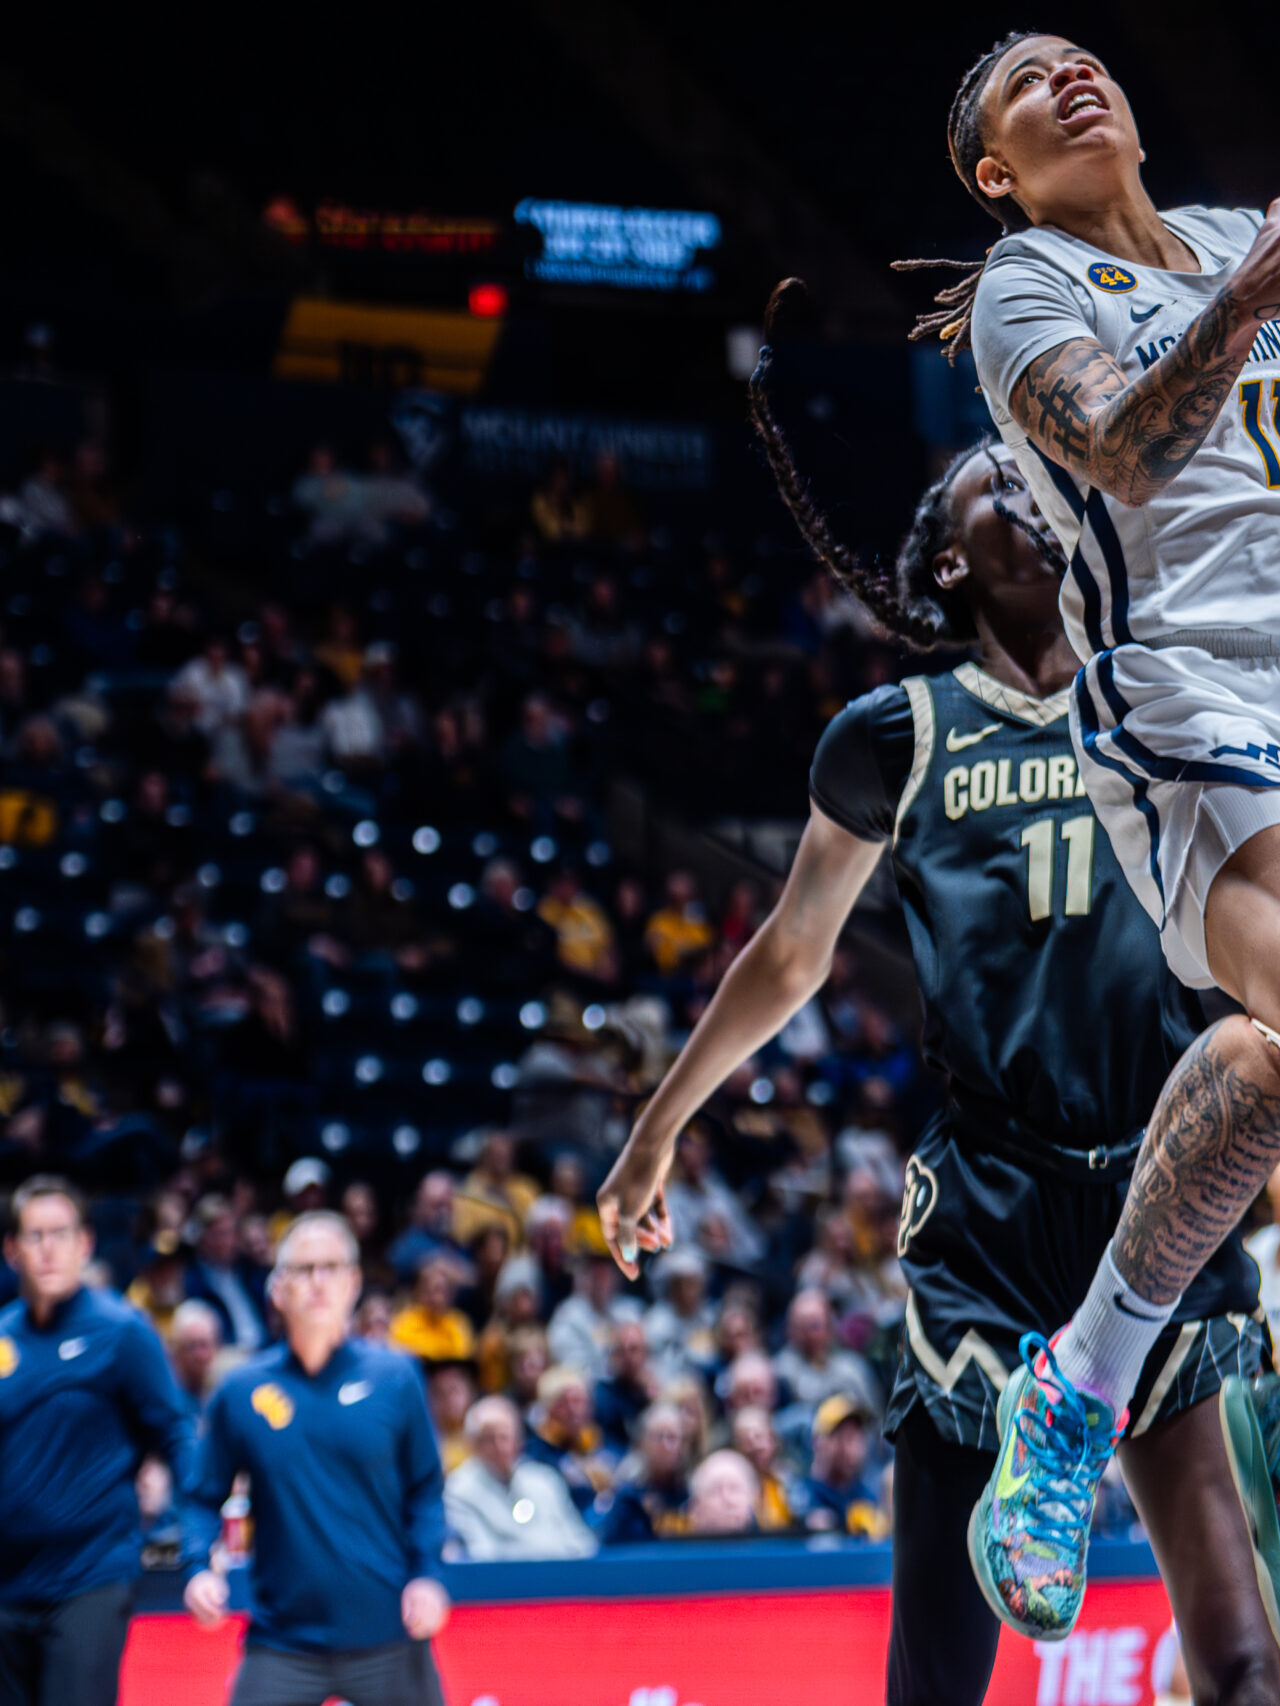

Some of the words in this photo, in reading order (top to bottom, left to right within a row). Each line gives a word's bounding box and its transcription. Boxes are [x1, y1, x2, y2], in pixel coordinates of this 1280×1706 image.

[1100, 269, 1131, 286] 44
[1021, 816, 1095, 922] 11
[1034, 1627, 1147, 1706] THE
